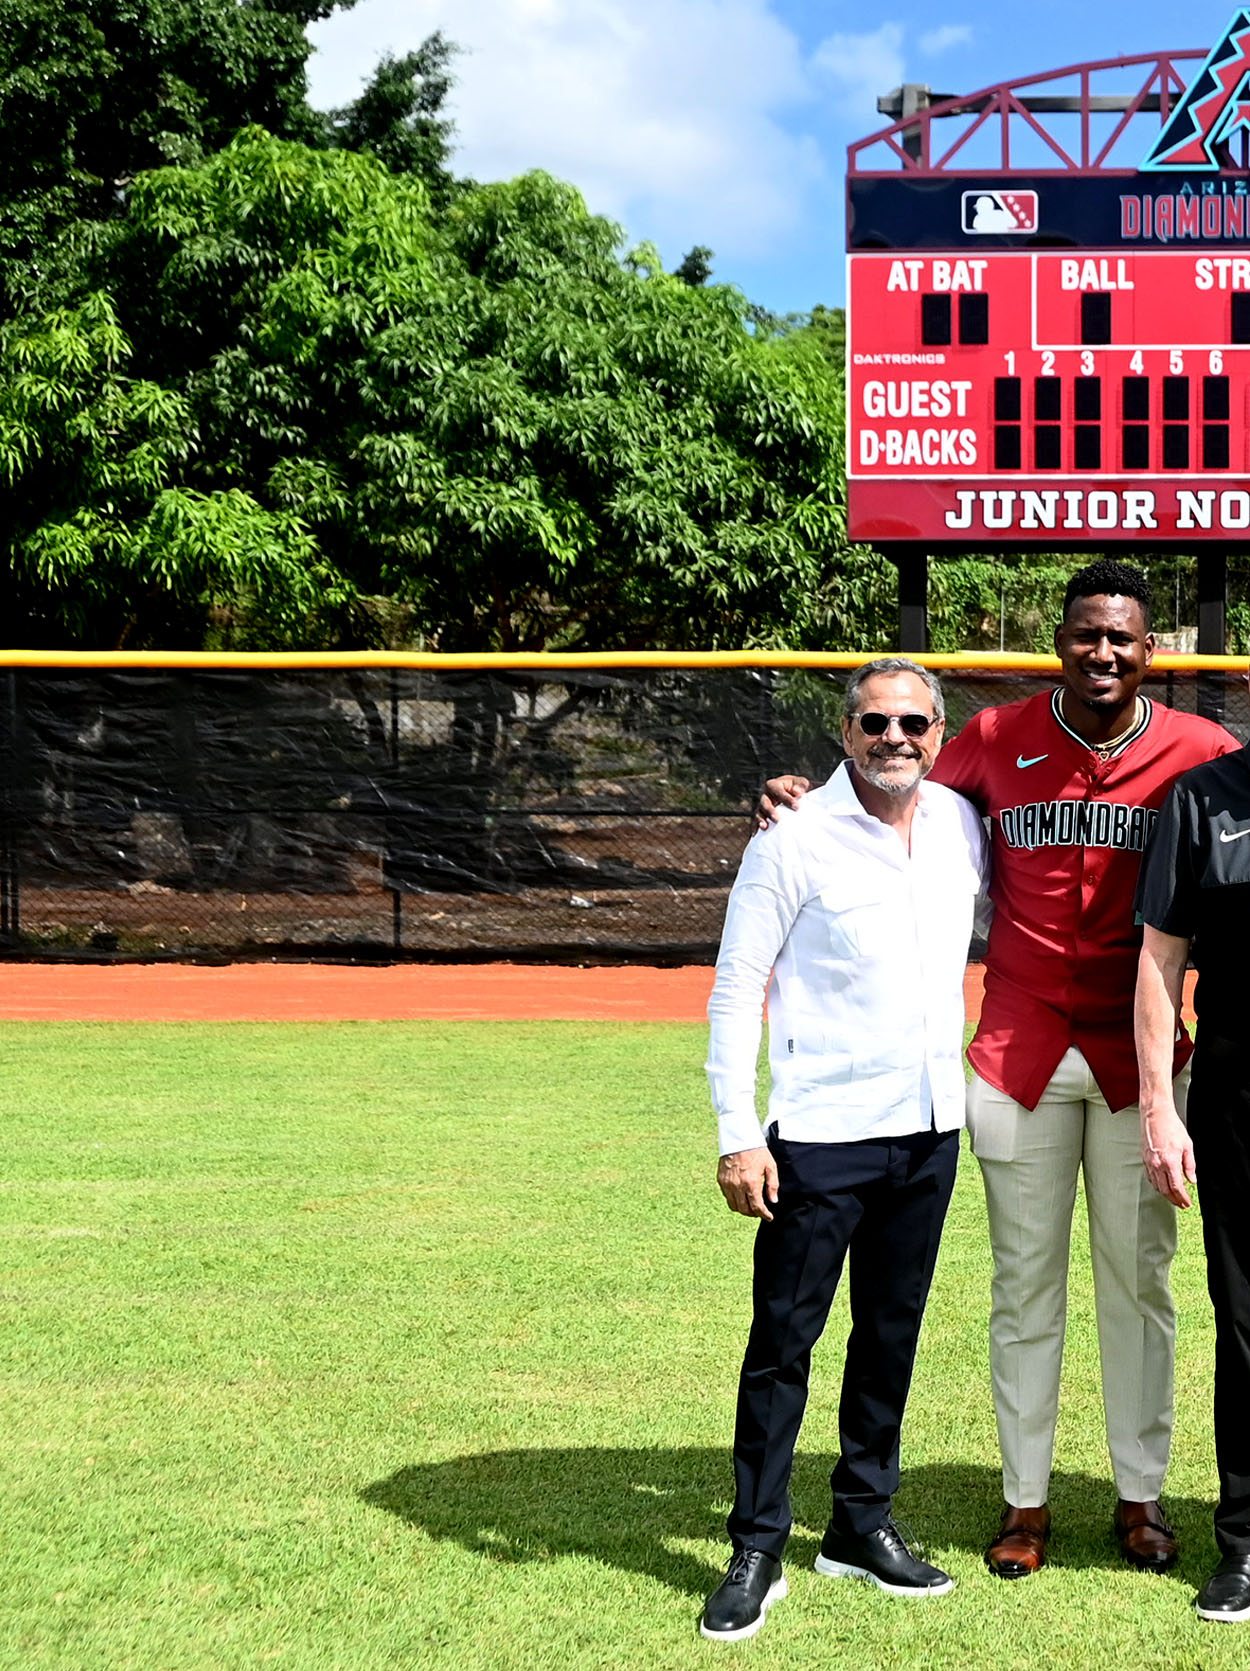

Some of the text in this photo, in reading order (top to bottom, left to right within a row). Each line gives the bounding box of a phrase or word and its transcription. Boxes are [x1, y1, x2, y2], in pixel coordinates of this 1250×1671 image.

[887, 260, 988, 292] AT BAT
[1061, 259, 1135, 291] BALL
[853, 353, 946, 365] DAKTRONICS
[1004, 350, 1015, 376] 1
[1041, 350, 1055, 376] 2
[1080, 350, 1095, 376] 3
[1129, 350, 1144, 376] 4
[1169, 350, 1184, 376] 5
[1208, 350, 1223, 376] 6
[863, 380, 973, 418] GUEST
[944, 490, 1158, 529] JUNIOR
[1000, 800, 1159, 851] DIAMONDBA
